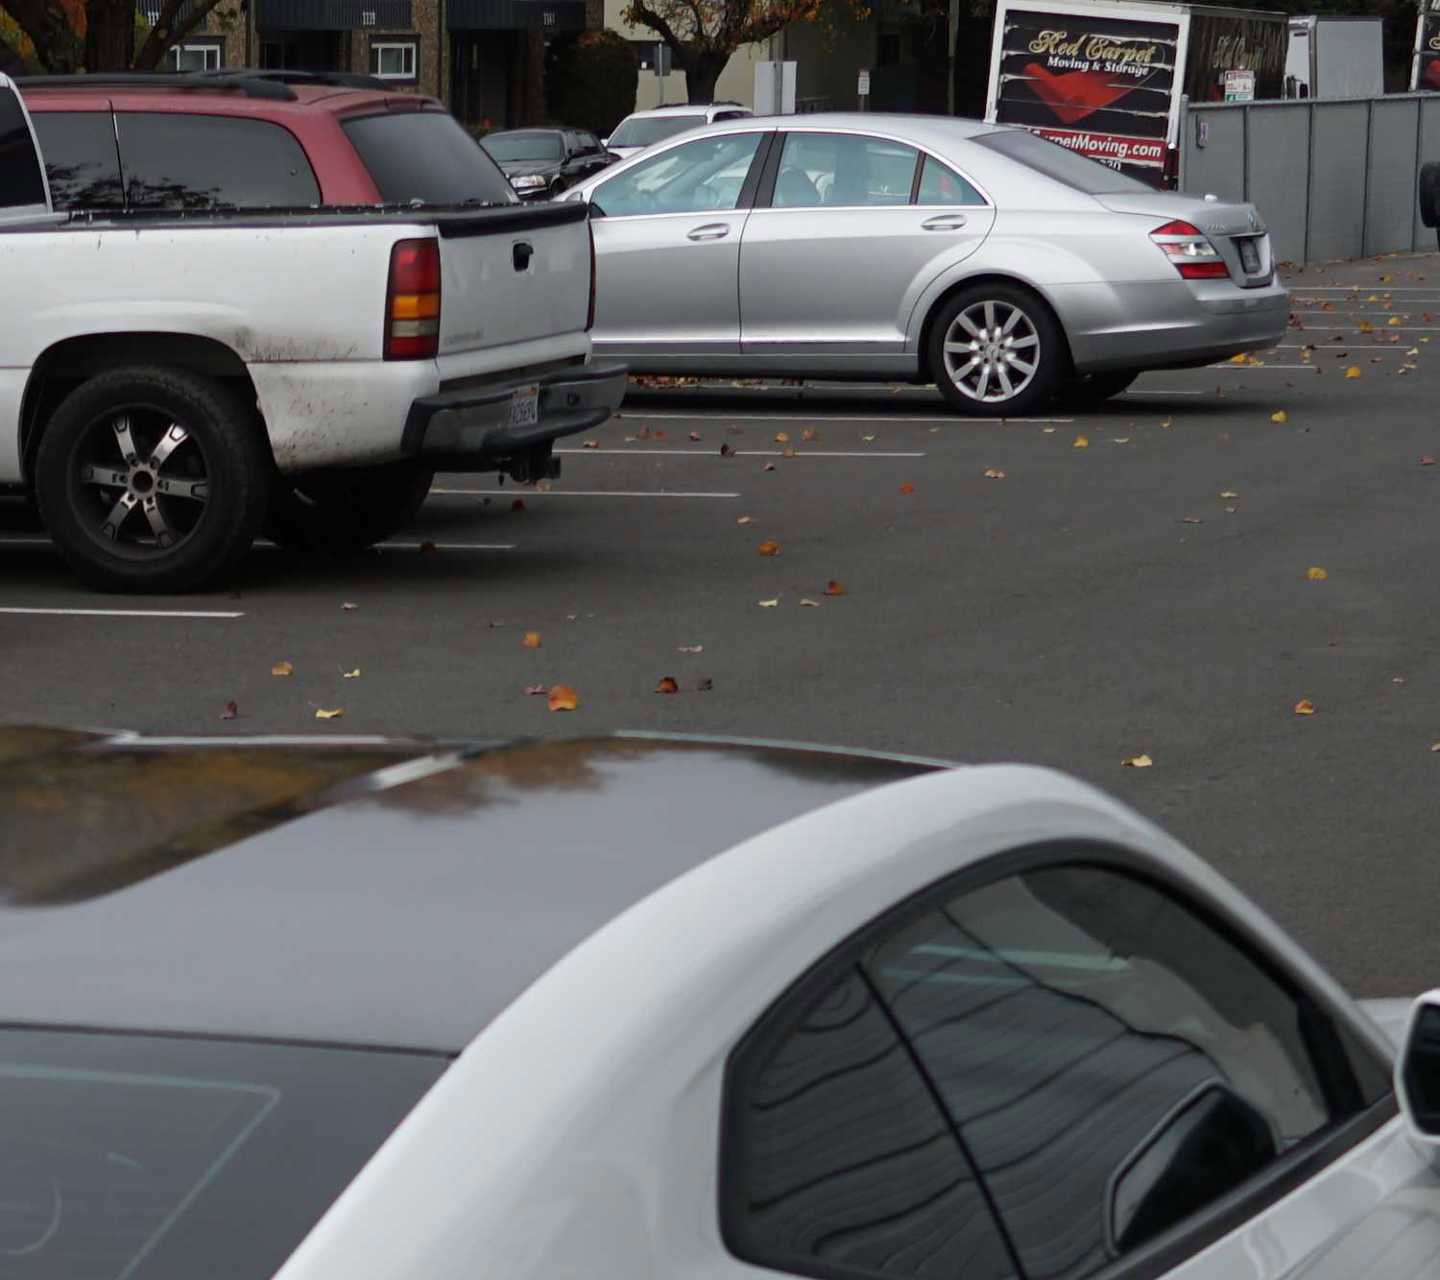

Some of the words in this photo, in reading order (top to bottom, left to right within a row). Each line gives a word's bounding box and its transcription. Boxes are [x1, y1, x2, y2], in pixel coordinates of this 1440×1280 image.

[1028, 30, 1089, 58] Red
[1085, 37, 1156, 64] Carpet
[1047, 56, 1090, 73] Moving
[1104, 61, 1150, 76] Storage
